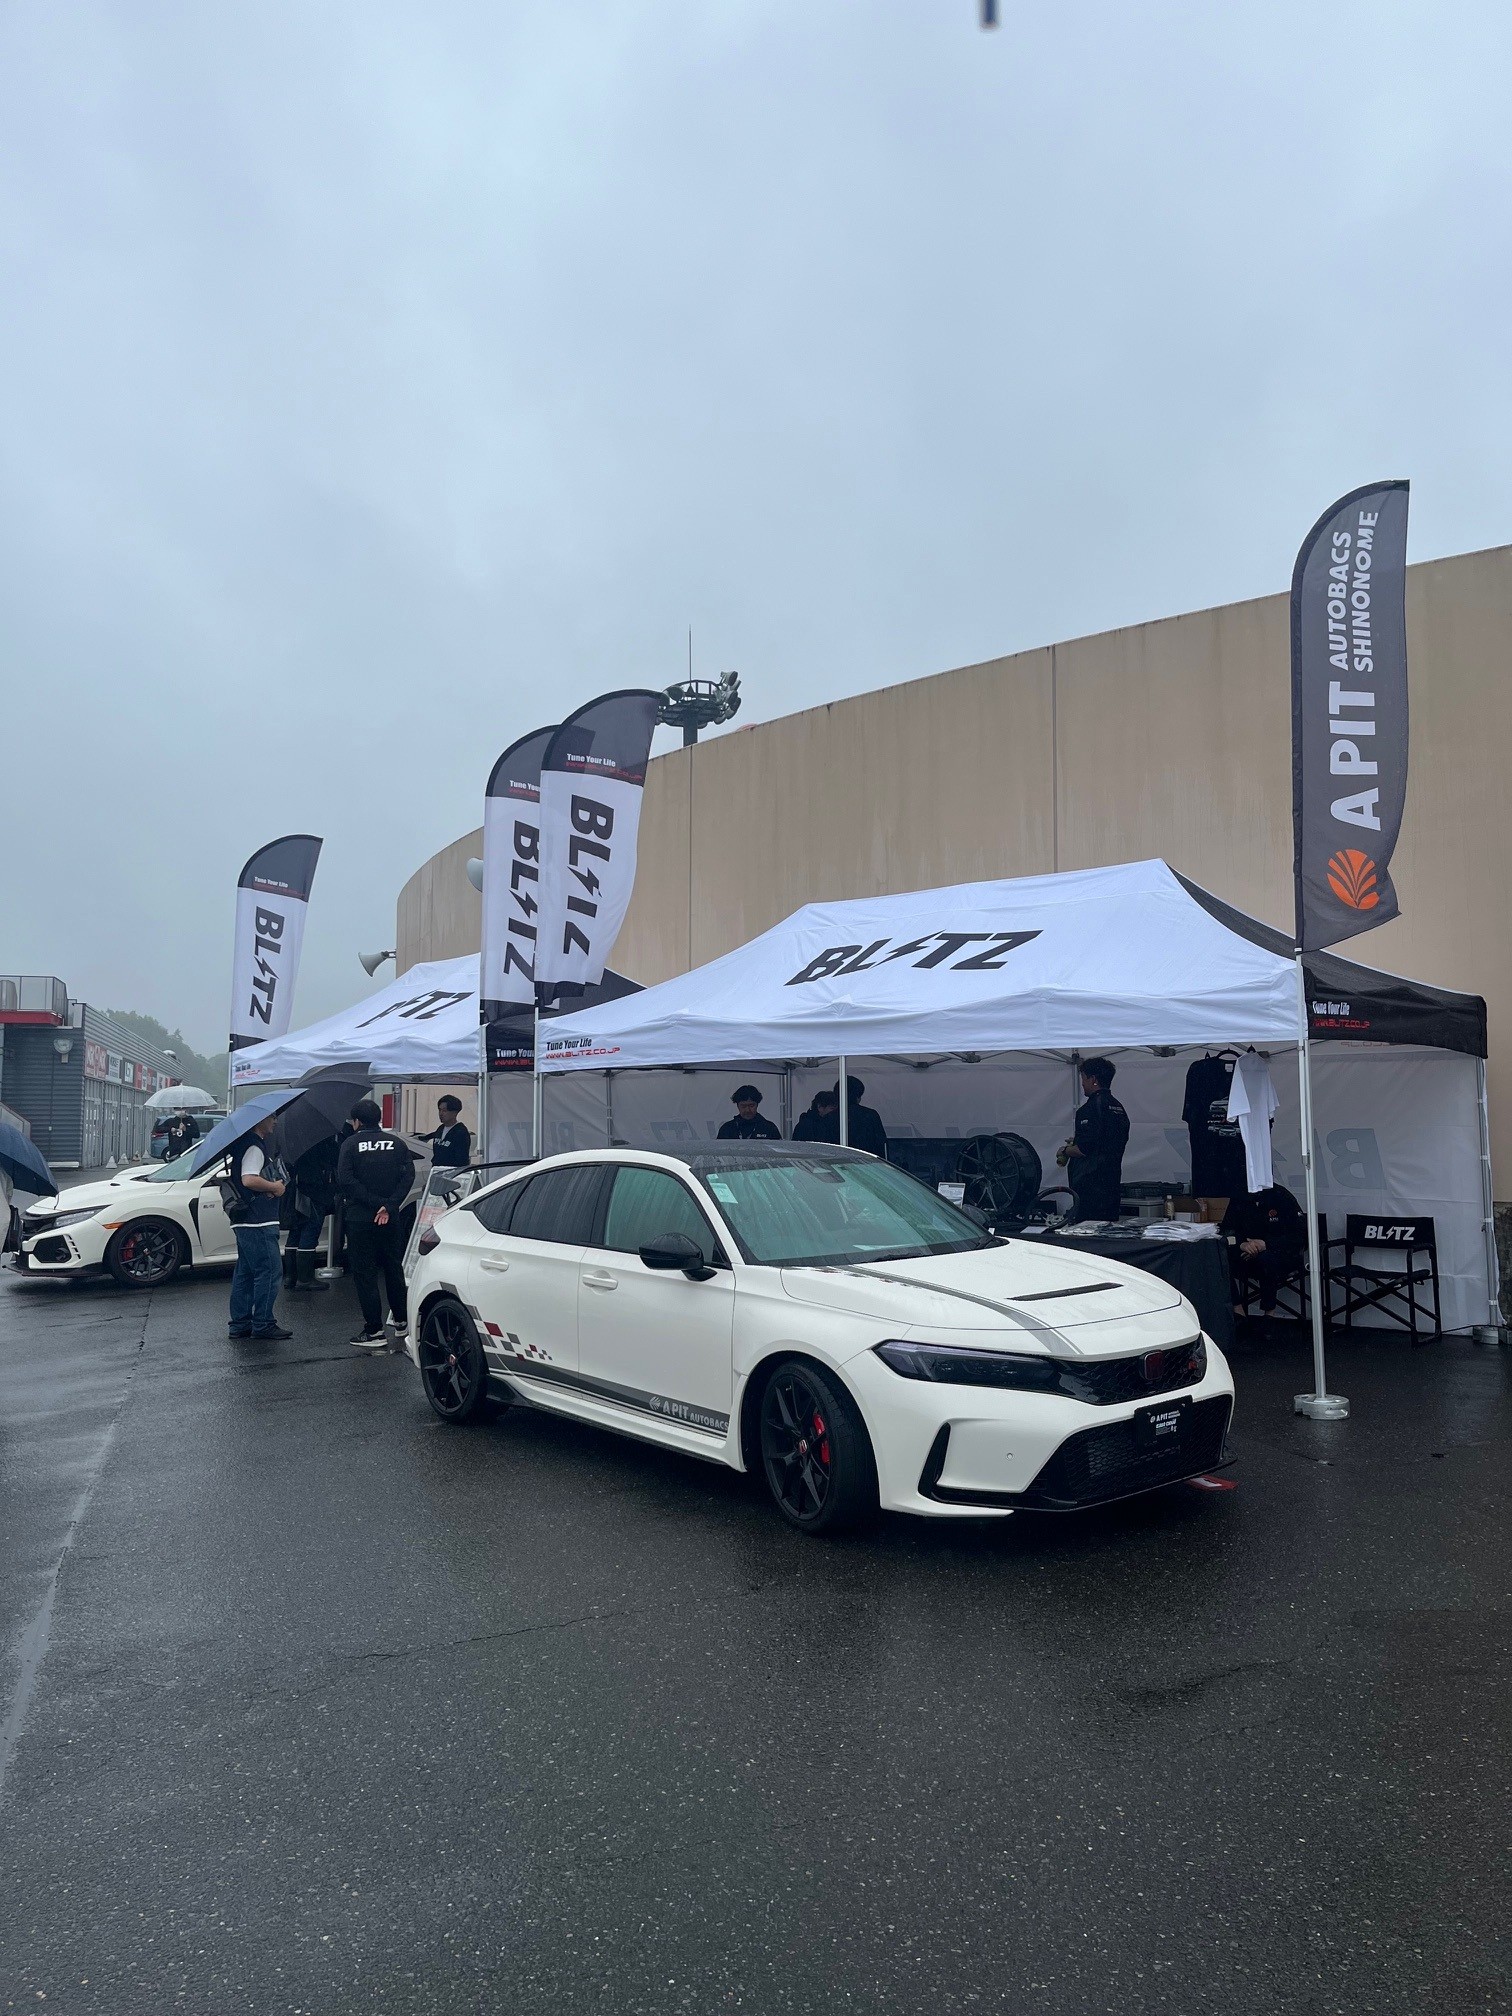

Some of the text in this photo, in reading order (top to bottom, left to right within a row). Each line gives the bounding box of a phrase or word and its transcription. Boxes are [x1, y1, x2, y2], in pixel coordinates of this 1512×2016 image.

[1351, 511, 1379, 673] SHINONOME
[1327, 531, 1352, 671] AUTOBACS
[567, 753, 616, 767] Tune Your Life
[1329, 681, 1381, 831] A PIT
[510, 779, 527, 789] Tune
[249, 905, 285, 1025] BLITZ
[783, 929, 1044, 986] BLITZ
[1328, 1001, 1340, 1015] Your
[1340, 1002, 1350, 1016] Life
[547, 1037, 592, 1051] Tune Your Life
[496, 1048, 516, 1057] Tune
[358, 1141, 394, 1152] BLITZ
[1364, 1225, 1416, 1241] BLITZ
[663, 1400, 729, 1431] A PIT AUTOBACS
